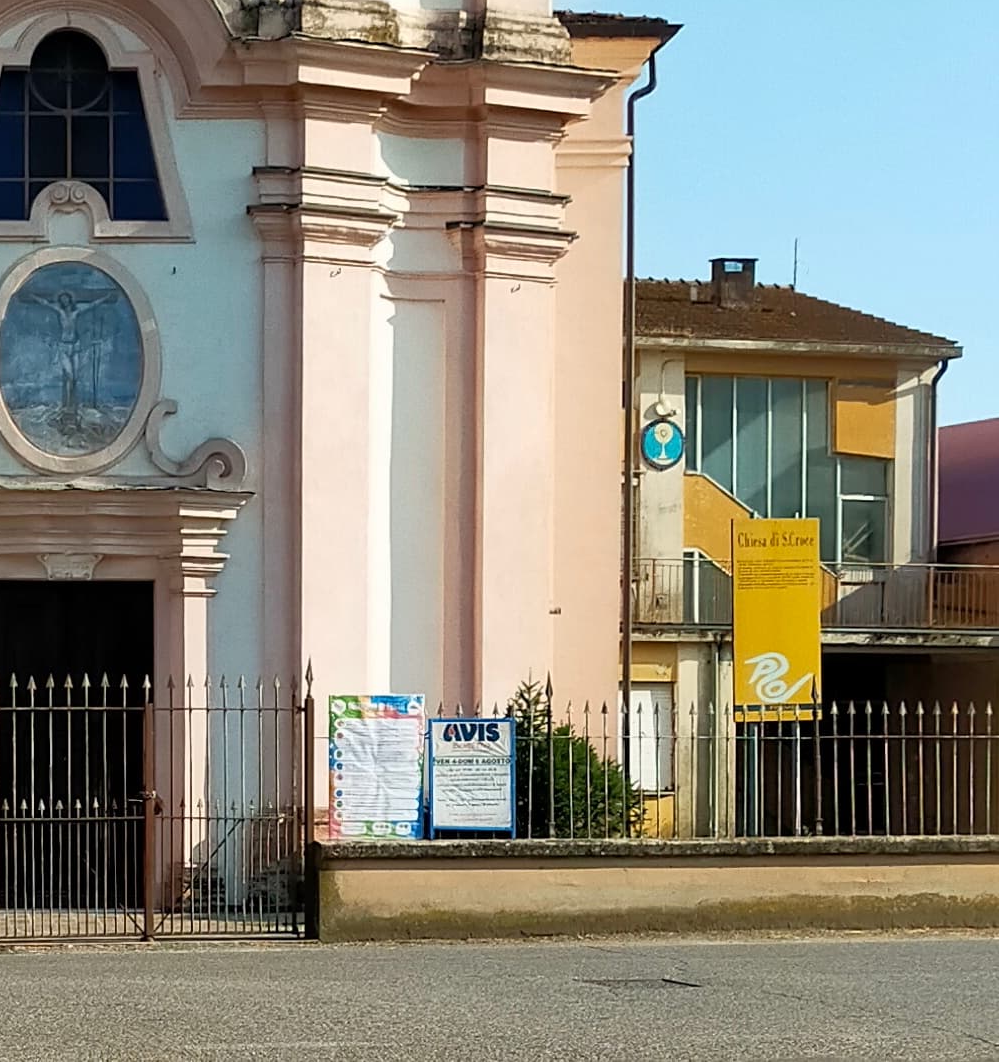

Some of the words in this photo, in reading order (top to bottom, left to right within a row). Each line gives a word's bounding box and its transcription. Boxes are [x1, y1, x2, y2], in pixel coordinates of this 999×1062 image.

[737, 531, 767, 548] Chiesa
[769, 531, 780, 547] di
[442, 722, 501, 743] AVIS
